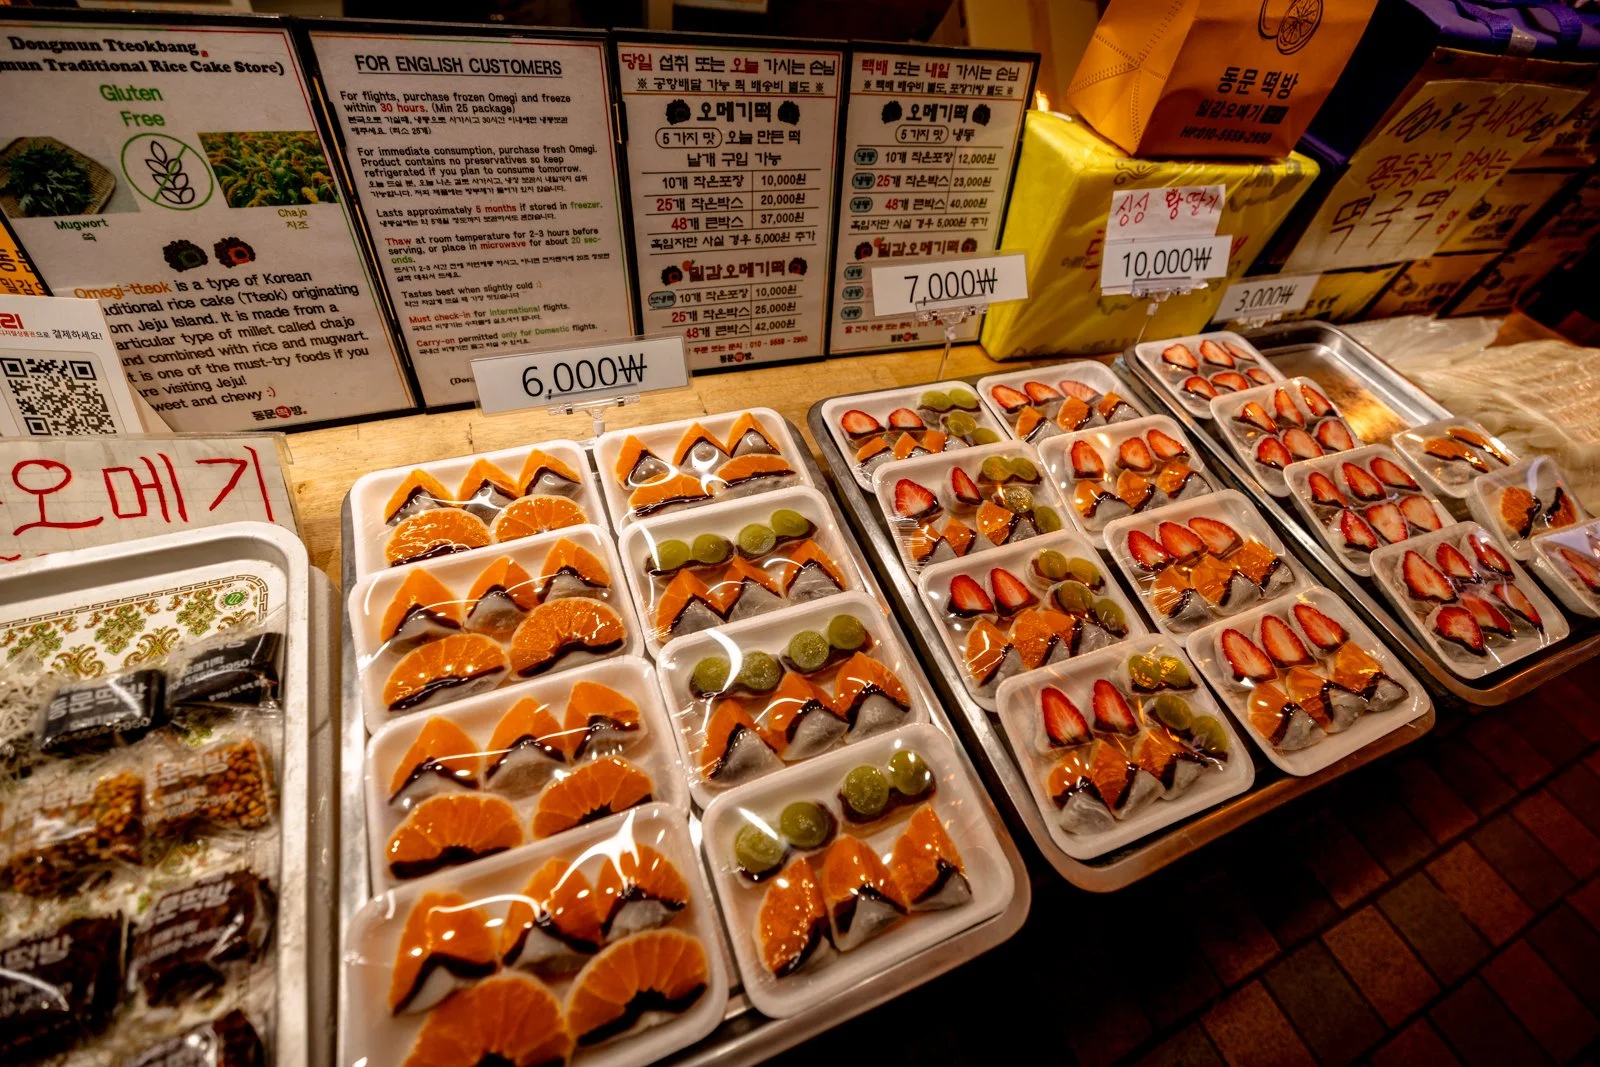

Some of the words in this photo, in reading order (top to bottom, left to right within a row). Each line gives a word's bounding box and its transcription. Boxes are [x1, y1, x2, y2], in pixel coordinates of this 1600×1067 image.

[7, 36, 102, 53] Dongmun
[43, 58, 148, 72] Traditional
[149, 60, 188, 72] Rice
[190, 61, 232, 73] Cake
[234, 61, 284, 76] Store)
[355, 54, 390, 72] FOR
[395, 55, 464, 73] ENGLISH
[469, 58, 562, 75] CUSTOMERS
[621, 53, 653, 72] 당일
[659, 54, 689, 73] 섭취
[695, 56, 726, 73] 또는
[730, 57, 758, 74] 오늘
[763, 58, 805, 76] 가시는
[810, 60, 835, 76] 손님
[893, 60, 921, 77] 또는
[925, 61, 950, 79] 내일
[956, 63, 992, 82] 가시는
[996, 66, 1020, 83] 손님
[100, 84, 163, 101] Gluten
[707, 78, 730, 92] 가능
[1216, 66, 1259, 96] 동문
[1260, 71, 1299, 100] 떡방
[340, 90, 358, 101] For
[363, 91, 400, 103] flights,
[403, 92, 449, 102] purchase
[453, 92, 485, 102] frozen
[488, 92, 518, 105] Omegi
[522, 93, 539, 103] and
[542, 93, 571, 103] freeze
[344, 102, 376, 113] within
[380, 102, 393, 112] 30
[397, 103, 428, 113] hours.
[432, 103, 453, 114] (Min
[472, 103, 516, 115] package)
[697, 102, 771, 123] 오메기떡
[120, 111, 165, 127] Free
[673, 131, 698, 146] 가지
[702, 131, 716, 145] 맛
[725, 130, 753, 145] 오늘
[757, 129, 784, 145] 만든
[910, 128, 929, 142] 가지
[357, 147, 374, 157] For
[378, 146, 430, 157] immediate
[434, 145, 495, 157] consumption,
[499, 144, 539, 156] purchase
[543, 144, 566, 155] fresh
[721, 151, 748, 167] 구입
[754, 151, 782, 167] 가능
[360, 157, 401, 168] Product
[405, 156, 445, 167] contains
[464, 156, 526, 168] preservatives
[544, 154, 564, 165] keep
[365, 167, 425, 179] refrigerated
[440, 167, 457, 178] you
[461, 166, 480, 178] plan
[497, 164, 535, 174] consume
[538, 164, 581, 174] tomorrow.
[662, 176, 688, 190] 10개
[761, 173, 806, 187] 10,000원
[376, 208, 403, 219] Lasts
[407, 205, 472, 218] approximately
[485, 203, 516, 214] months
[529, 201, 557, 211] stored
[656, 197, 685, 211] 25개
[760, 192, 805, 207] 20,000원
[1115, 192, 1150, 228] 싱싱
[54, 217, 109, 232] Mugwort
[671, 216, 700, 231] 48개
[760, 211, 805, 225] 37,000원
[385, 236, 411, 247] Thaw
[429, 234, 451, 244] room
[455, 230, 510, 243] temperature
[547, 228, 569, 238] hours
[572, 226, 599, 236] before
[702, 234, 724, 247] 사실
[728, 233, 751, 246] 경우
[755, 231, 791, 246] 5,000원
[388, 245, 426, 257] serving,
[442, 243, 466, 254] place
[480, 239, 526, 250] microwave
[545, 236, 569, 247] about
[1122, 246, 1213, 280] 10,000₩
[74, 281, 172, 300] Omegi-tteok
[207, 277, 240, 292] type
[262, 271, 313, 285] Korean
[401, 289, 433, 300] Tastes
[436, 286, 457, 297] best
[459, 284, 481, 295] when
[483, 282, 513, 293] slightly
[680, 291, 702, 304] 10개
[756, 284, 797, 298] 10,000원
[904, 267, 998, 306] 7,000₩
[168, 298, 196, 310] rice
[201, 294, 235, 306] cake
[237, 288, 288, 305] (Tteok)
[293, 284, 360, 300] originating
[138, 319, 169, 333] Jeju
[173, 313, 219, 328] Island.
[252, 306, 290, 320] made
[294, 304, 326, 316] from
[434, 311, 470, 323] check-in
[490, 304, 541, 317] International
[671, 310, 698, 324] 25개
[755, 301, 797, 316] 25,000원
[181, 332, 215, 346] type
[239, 323, 276, 338] millet
[277, 319, 317, 333] called
[321, 315, 356, 330] chajo
[755, 318, 796, 333] 42,000원
[458, 332, 499, 345] permitted
[148, 346, 216, 363] combined
[219, 343, 250, 357] with
[253, 340, 279, 353] rice
[282, 336, 307, 349] and
[157, 368, 184, 380] one
[207, 362, 231, 373] the
[234, 355, 292, 371] must-try
[296, 350, 332, 364] foods
[347, 346, 370, 359] you
[163, 381, 212, 395] visiting
[217, 375, 248, 388] Jeju!
[522, 352, 648, 400] 6,000₩
[192, 394, 218, 407] and
[221, 390, 263, 403] chewy
